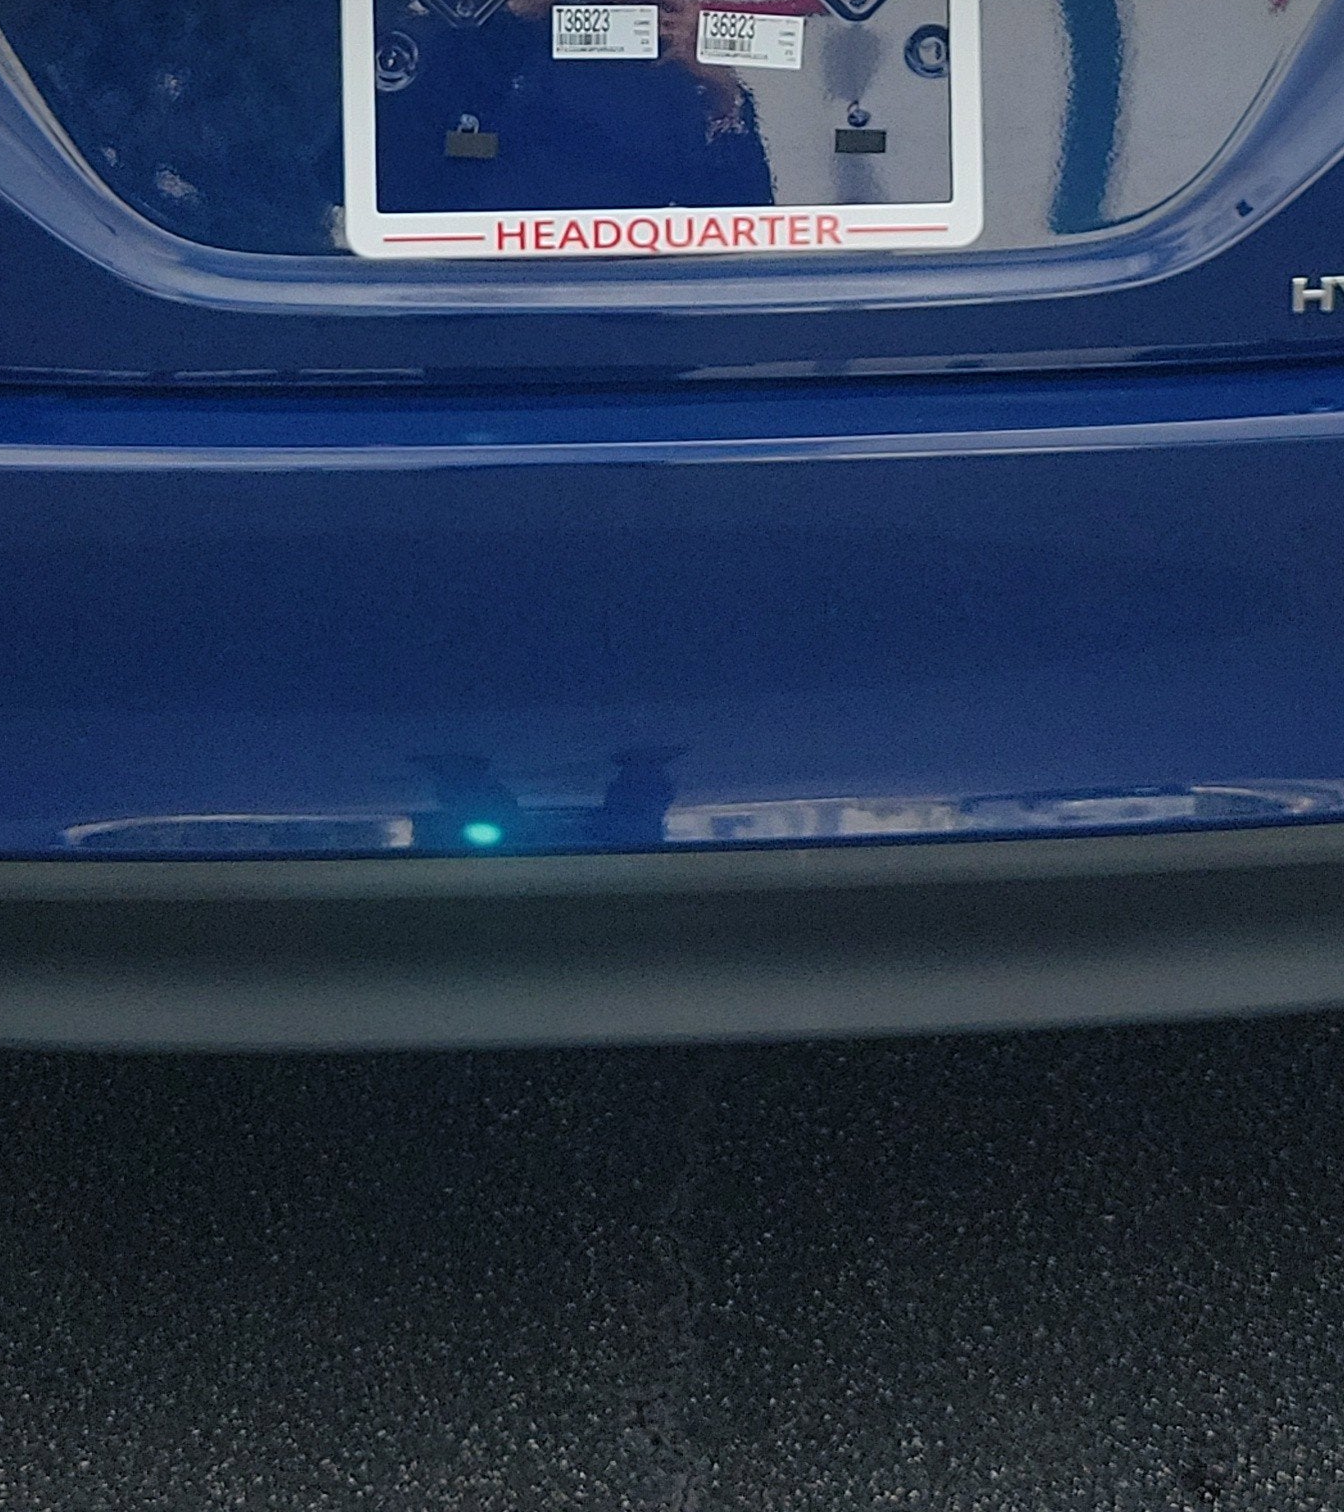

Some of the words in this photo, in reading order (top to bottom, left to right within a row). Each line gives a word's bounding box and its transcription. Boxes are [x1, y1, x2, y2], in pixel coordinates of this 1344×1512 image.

[556, 8, 611, 32] T36823
[702, 12, 755, 39] T36823
[495, 214, 843, 252] HEADQUARTER
